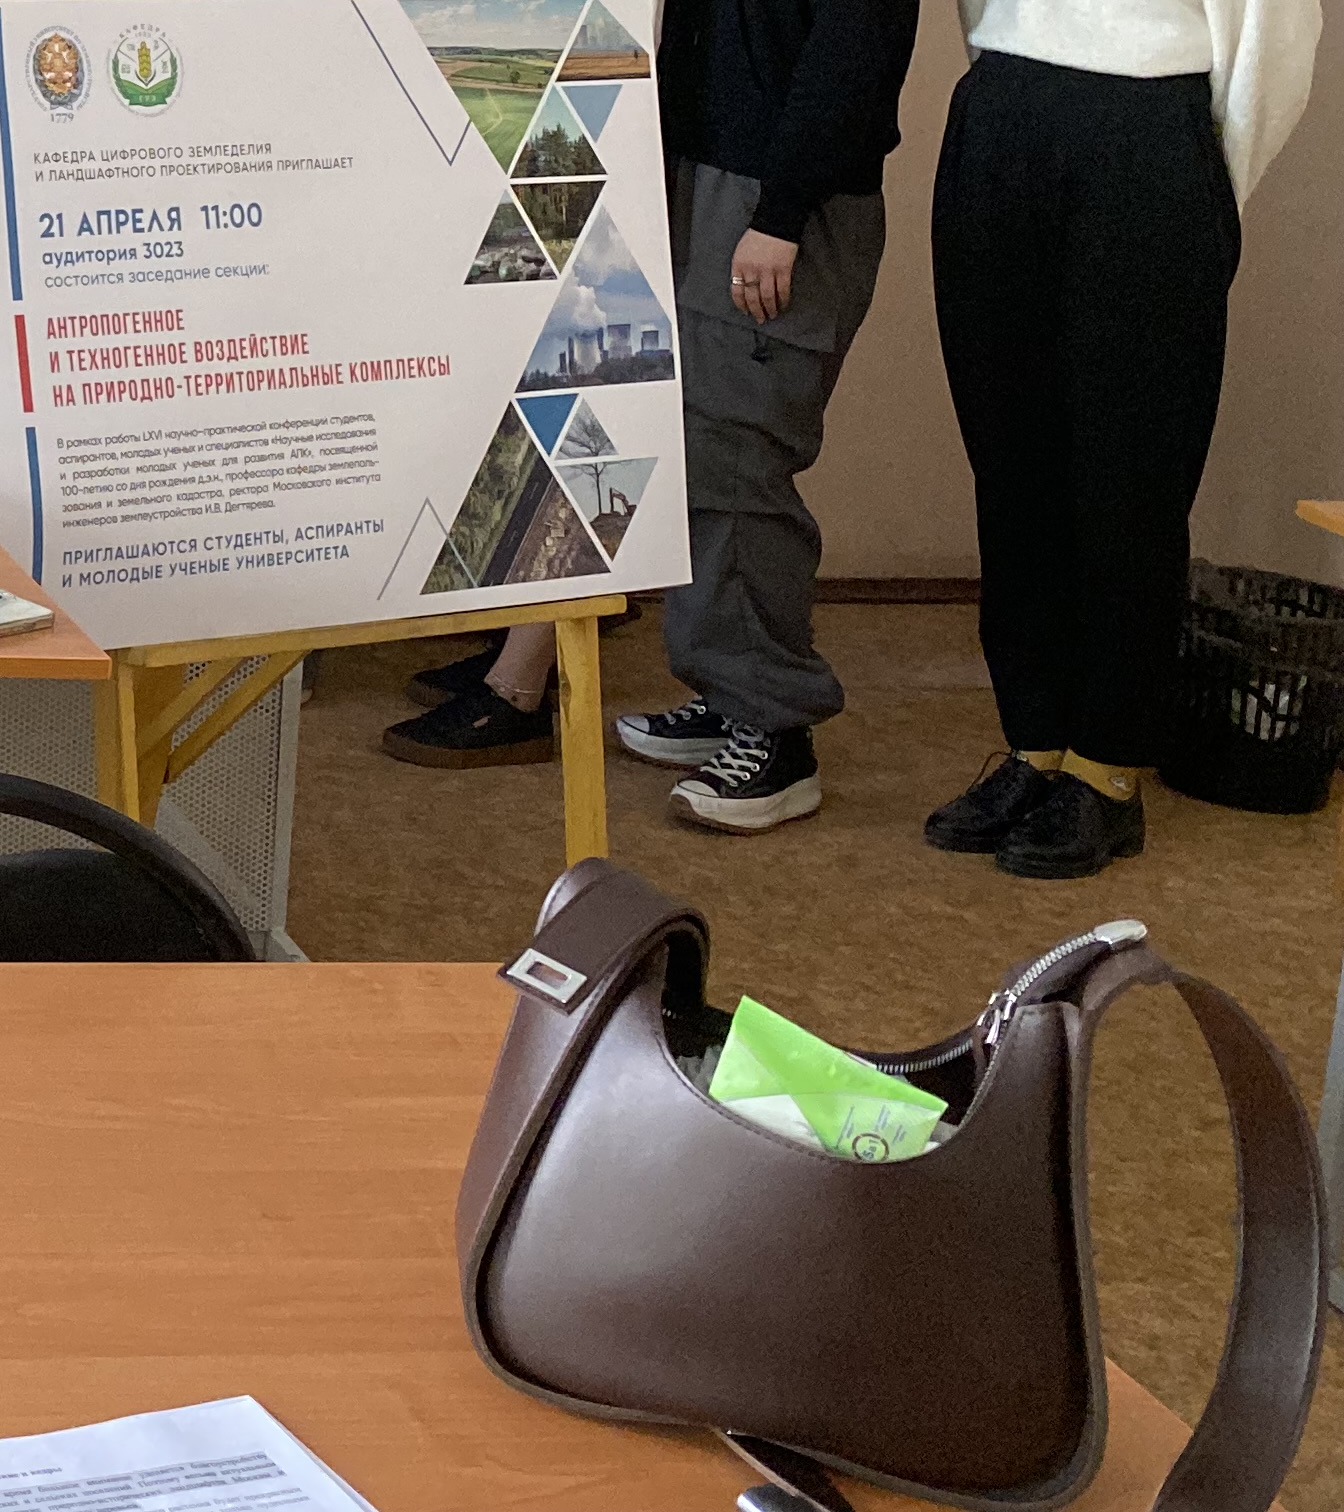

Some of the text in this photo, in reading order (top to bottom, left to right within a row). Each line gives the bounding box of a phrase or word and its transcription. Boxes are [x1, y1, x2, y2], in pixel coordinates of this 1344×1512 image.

[50, 113, 75, 123] 1779
[33, 143, 272, 164] КАФЕДРА ЦИФРОВОГО ЗЕМЛЕДЕЛИЯ
[35, 156, 354, 182] И ЛАНДШАФТНОГО ПРОЕКТИРОВАНИЯ ПРИГЛАШАЕТ
[39, 202, 263, 238] 21 АПРЕЛЯ 11:00
[42, 241, 185, 269] аудитория 3023
[44, 263, 270, 289] состоится заседание секции:
[46, 309, 185, 340] АНТРОПОГЕННОЕ
[49, 332, 310, 374] И ТЕХНОГЕННОЕ ВОЗДЕЙСТВИЕ
[53, 354, 451, 408] НА ПРИРОДНО-ТЕРРИТОРИАЛЬНЫЕ КОМПЛЕКСЫ
[57, 438, 64, 449] В
[66, 437, 102, 450] рамках
[105, 433, 141, 447] работы
[165, 421, 267, 441] научно-практической
[58, 450, 119, 466] аспирантов,
[121, 447, 161, 460] молодых
[163, 445, 196, 458] ученых
[198, 444, 204, 452] и
[60, 472, 66, 481] и
[72, 466, 130, 482] разработки
[136, 461, 177, 473] молодых
[183, 459, 216, 472] ученых
[222, 456, 238, 467] для
[60, 483, 114, 497] 100-летию
[115, 482, 128, 492] со
[129, 480, 147, 493] дня
[148, 476, 196, 491] рождения
[62, 500, 102, 513] зования
[106, 499, 113, 508] и
[117, 493, 173, 508] земельного
[62, 515, 118, 530] инженеров
[120, 507, 203, 524] землеустройства
[63, 518, 385, 565] ПРИГЛАШАЮТСЯ СТУДЕНТЫ, АСПИРАНТЫ
[62, 544, 350, 588] И МОЛОДЫЕ УЧЕНЫЕ УНИВЕРСИТЕТА
